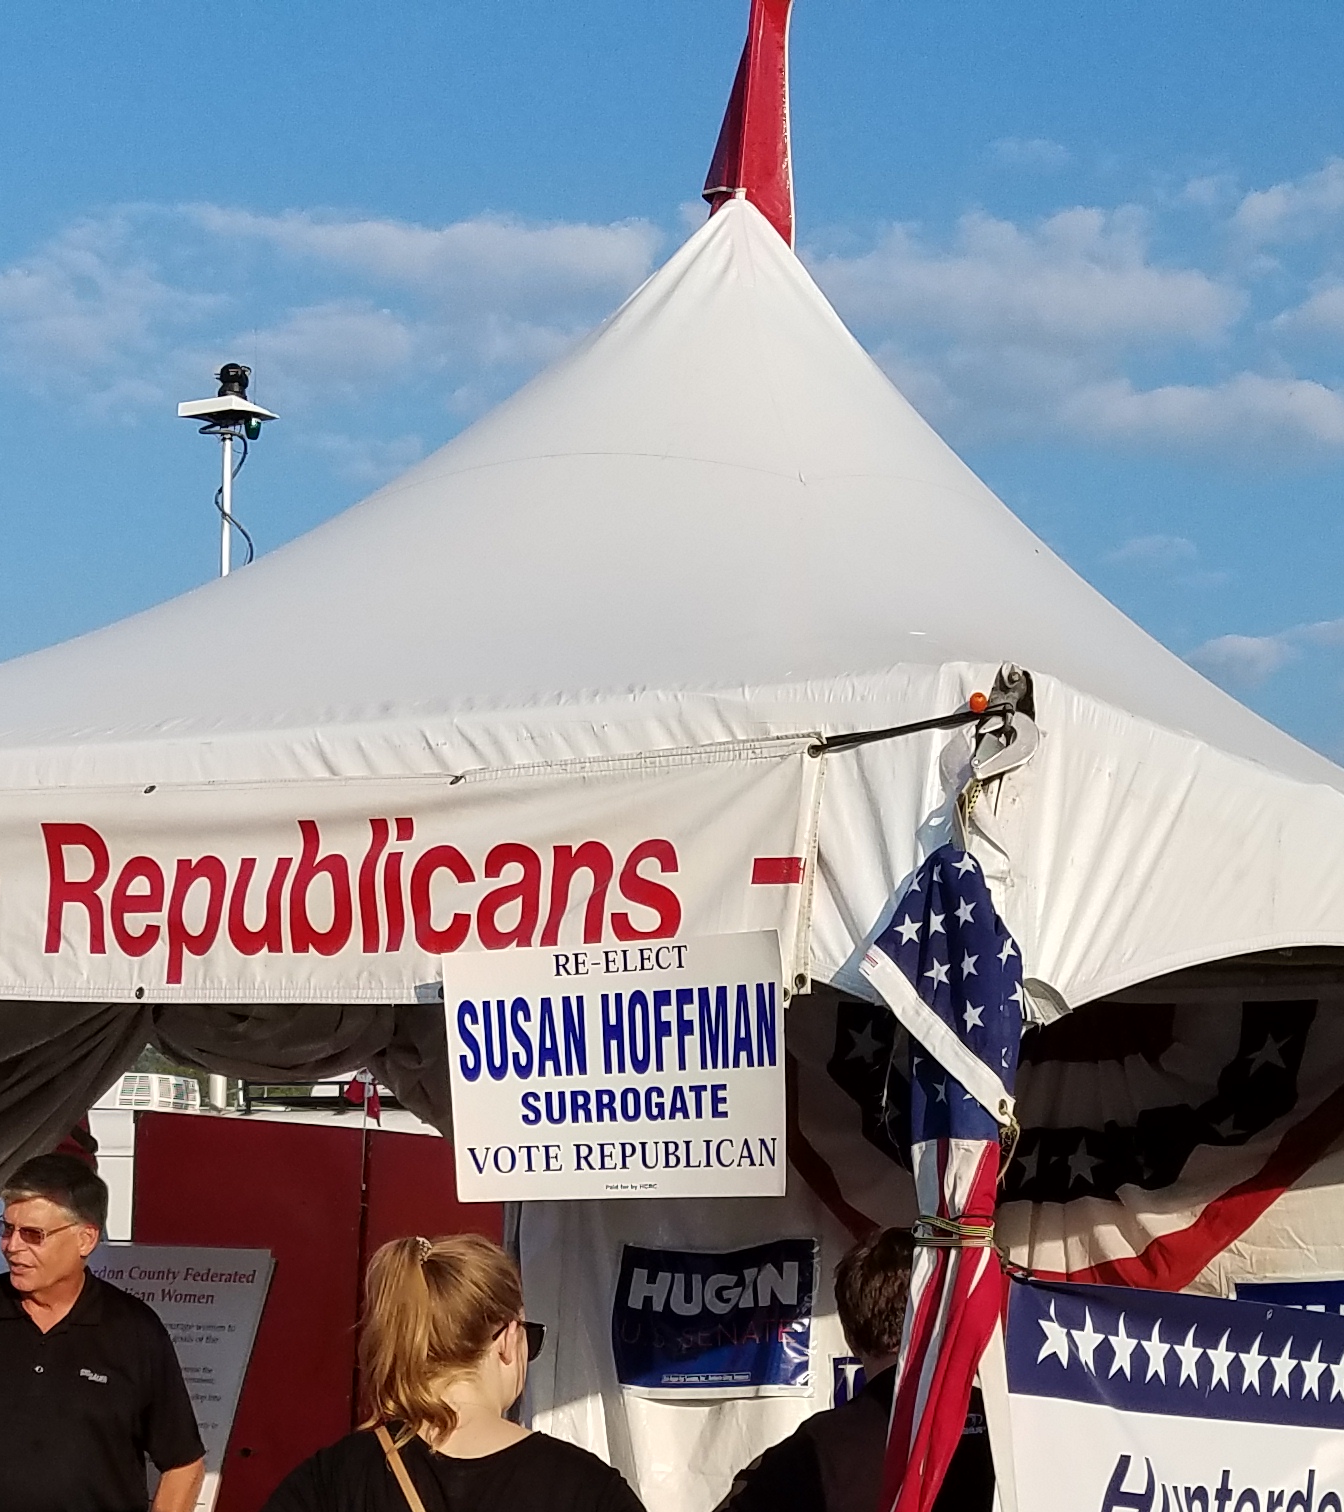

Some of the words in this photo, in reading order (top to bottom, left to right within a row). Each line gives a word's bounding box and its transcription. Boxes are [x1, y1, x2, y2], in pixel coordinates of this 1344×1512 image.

[40, 817, 681, 984] Republicans
[553, 945, 687, 976] RE-ELECT
[457, 995, 587, 1082] SUSAN
[601, 982, 776, 1074] HOFFMAN
[521, 1084, 729, 1125] SURROGATE
[467, 1145, 562, 1174] VOTE
[573, 1138, 777, 1171] REPUBLICAN
[128, 1266, 180, 1285] County
[183, 1268, 256, 1284] Federated
[628, 1262, 798, 1315] HUGIN
[160, 1289, 214, 1304] Women
